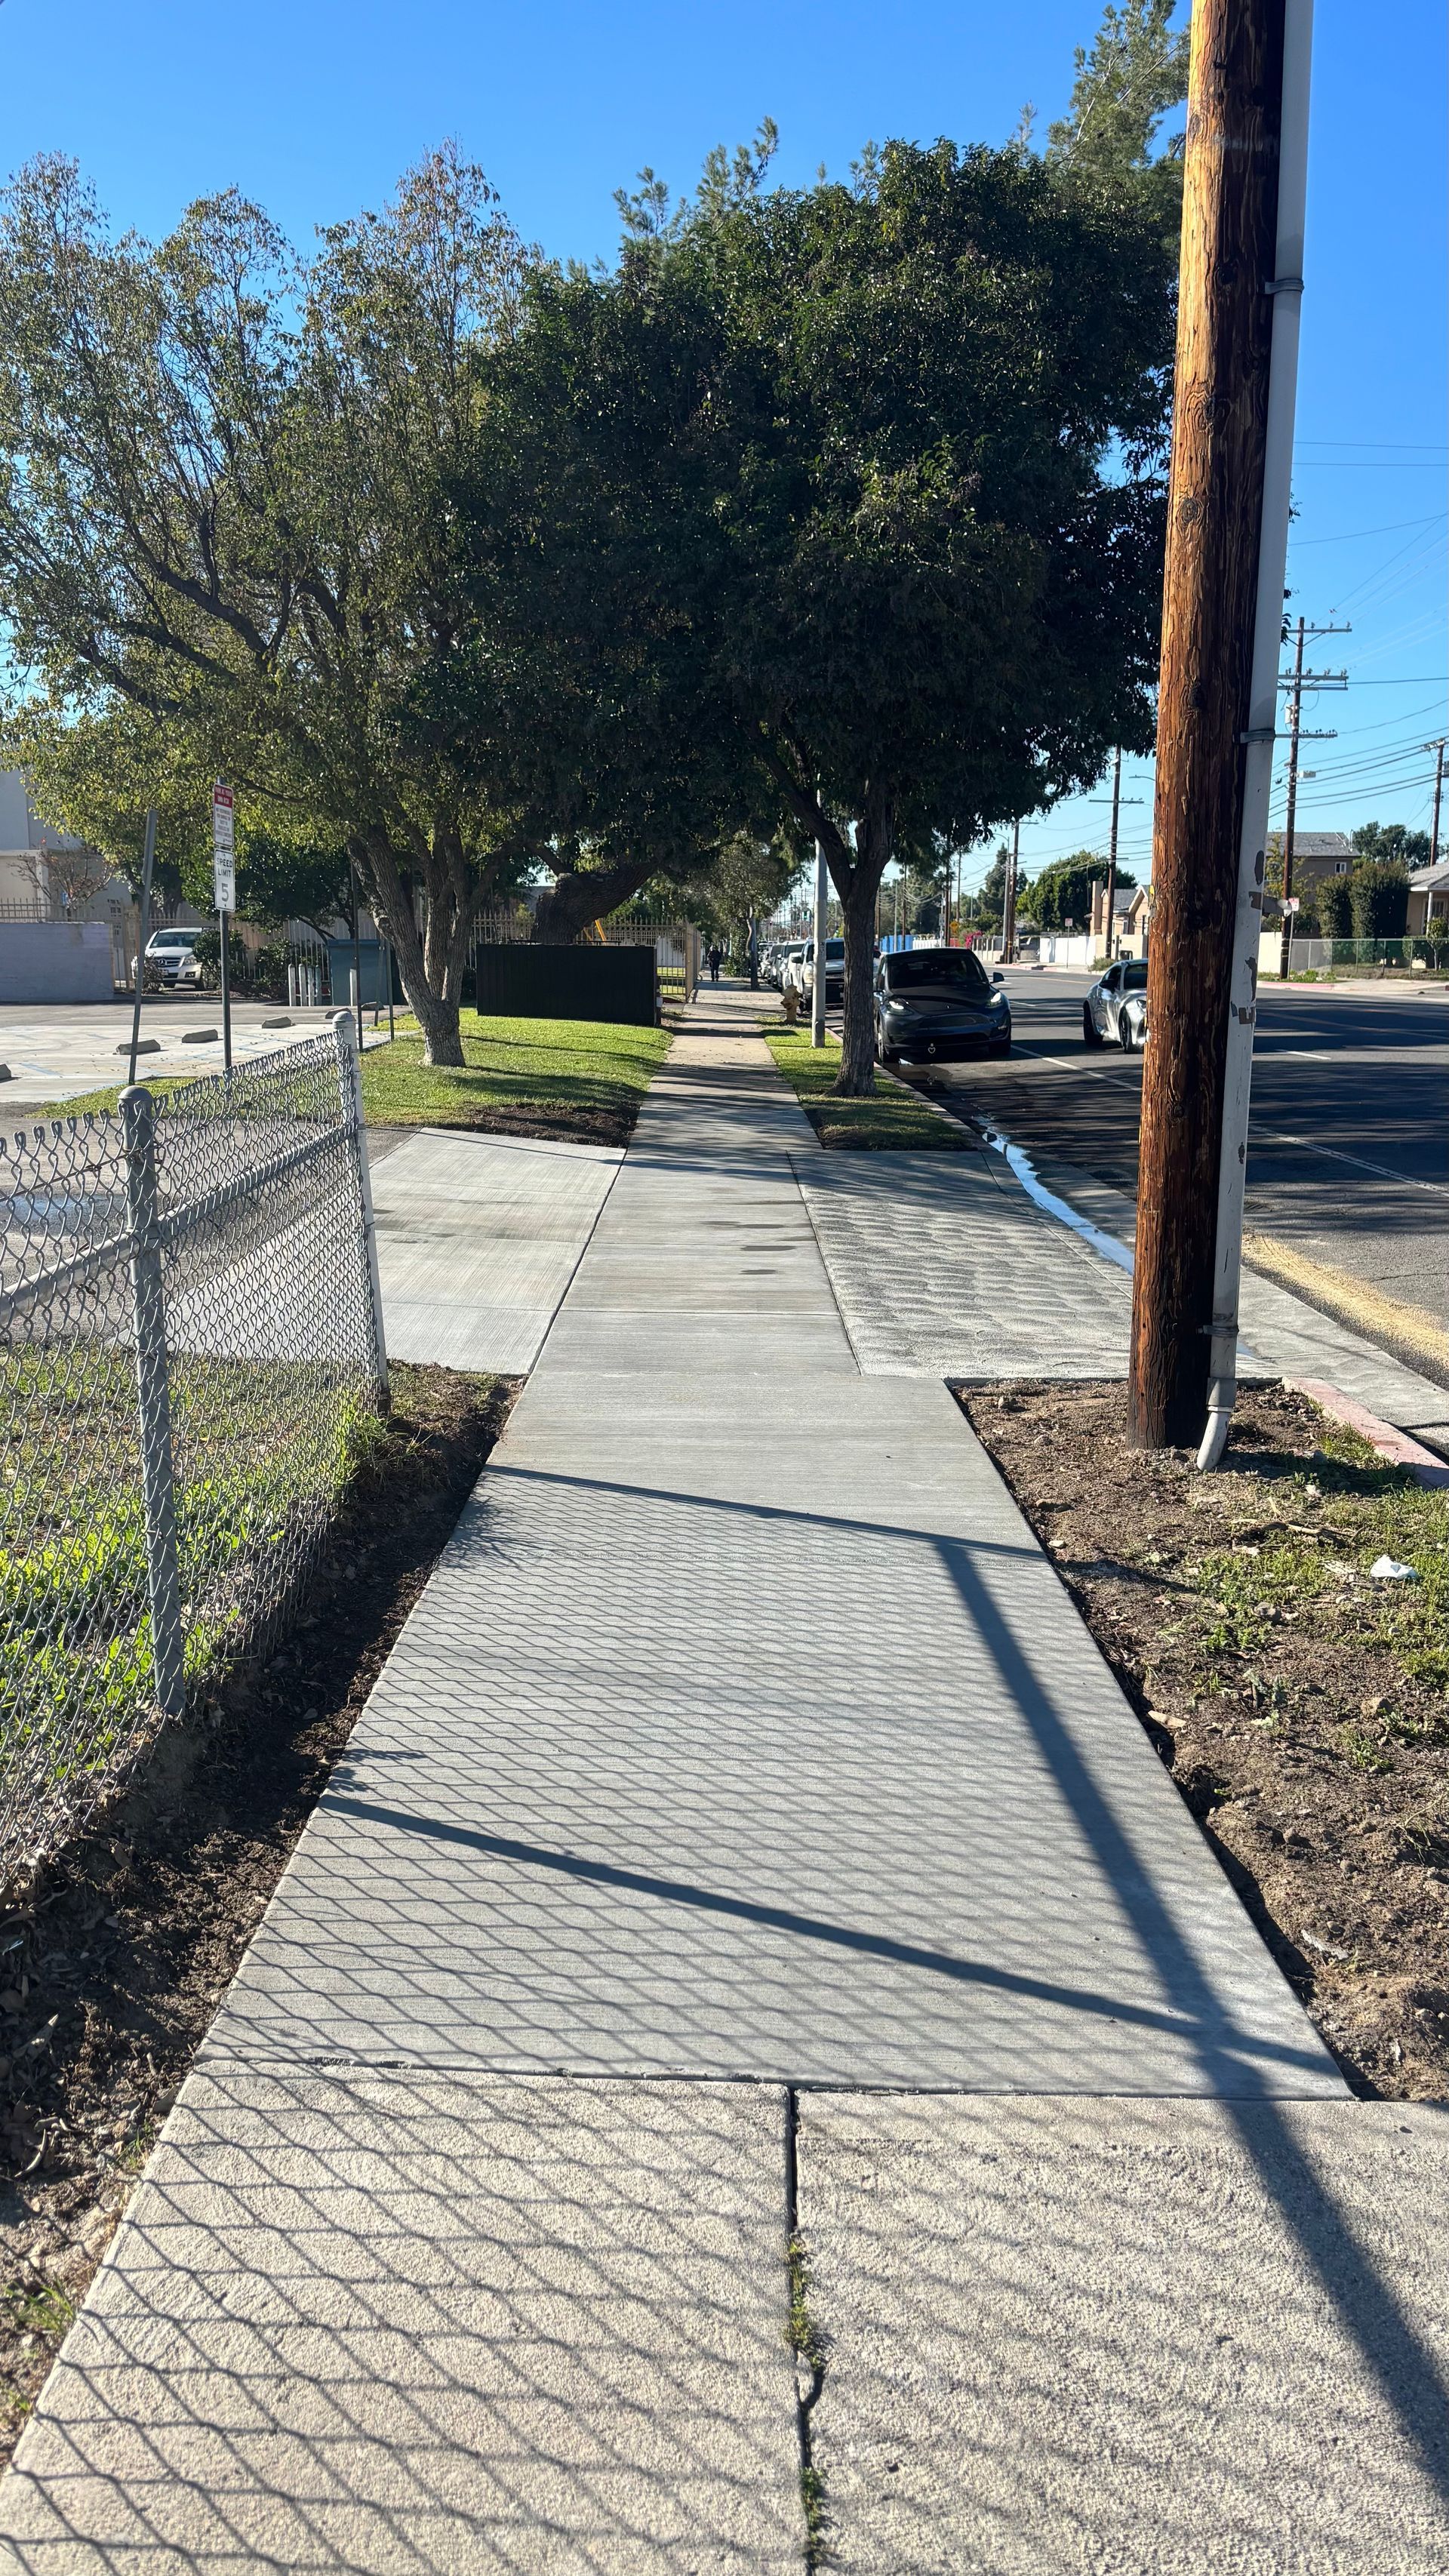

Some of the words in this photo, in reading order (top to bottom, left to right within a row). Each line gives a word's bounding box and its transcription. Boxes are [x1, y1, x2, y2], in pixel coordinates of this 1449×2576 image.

[217, 857, 232, 868] SPEED
[218, 867, 231, 877] LIMIT
[221, 882, 229, 902] 5
